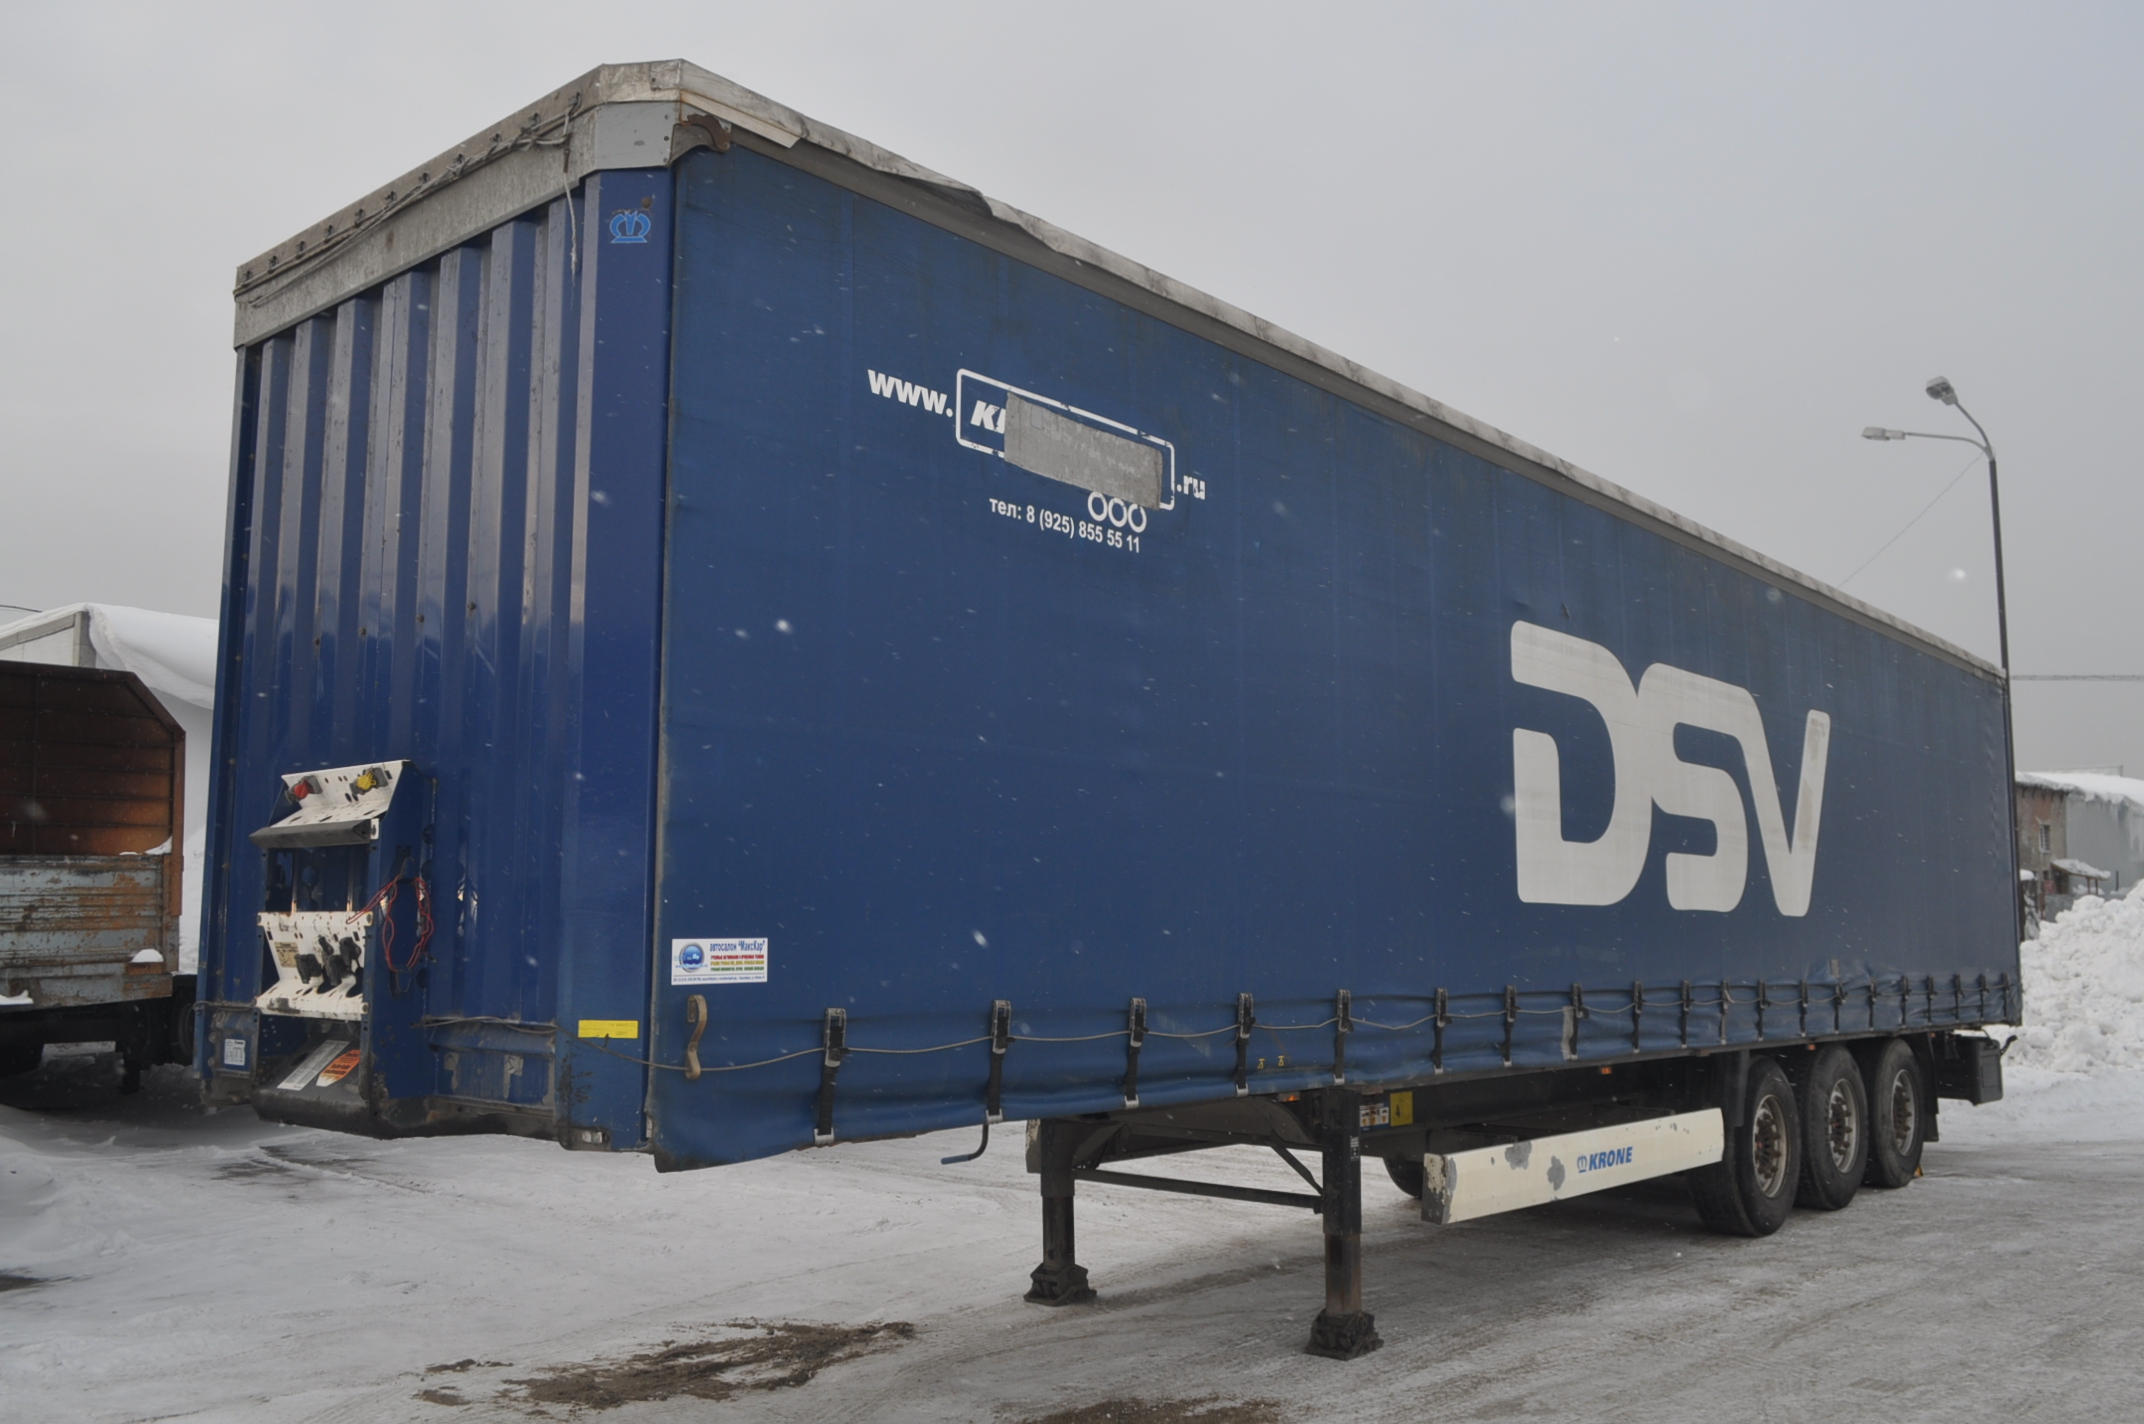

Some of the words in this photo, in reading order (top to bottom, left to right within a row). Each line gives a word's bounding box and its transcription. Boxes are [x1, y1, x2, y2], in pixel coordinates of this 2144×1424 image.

[867, 369, 954, 418] www.
[1176, 474, 1206, 501] .ru
[988, 497, 1022, 521] тел:
[1026, 504, 1036, 524] 8
[1039, 508, 1075, 539] (925)
[1078, 520, 1104, 543] 855
[1106, 528, 1123, 549] 55
[1126, 534, 1140, 554] 11
[1510, 619, 1831, 917] DSV
[1588, 1146, 1634, 1172] KRONE
